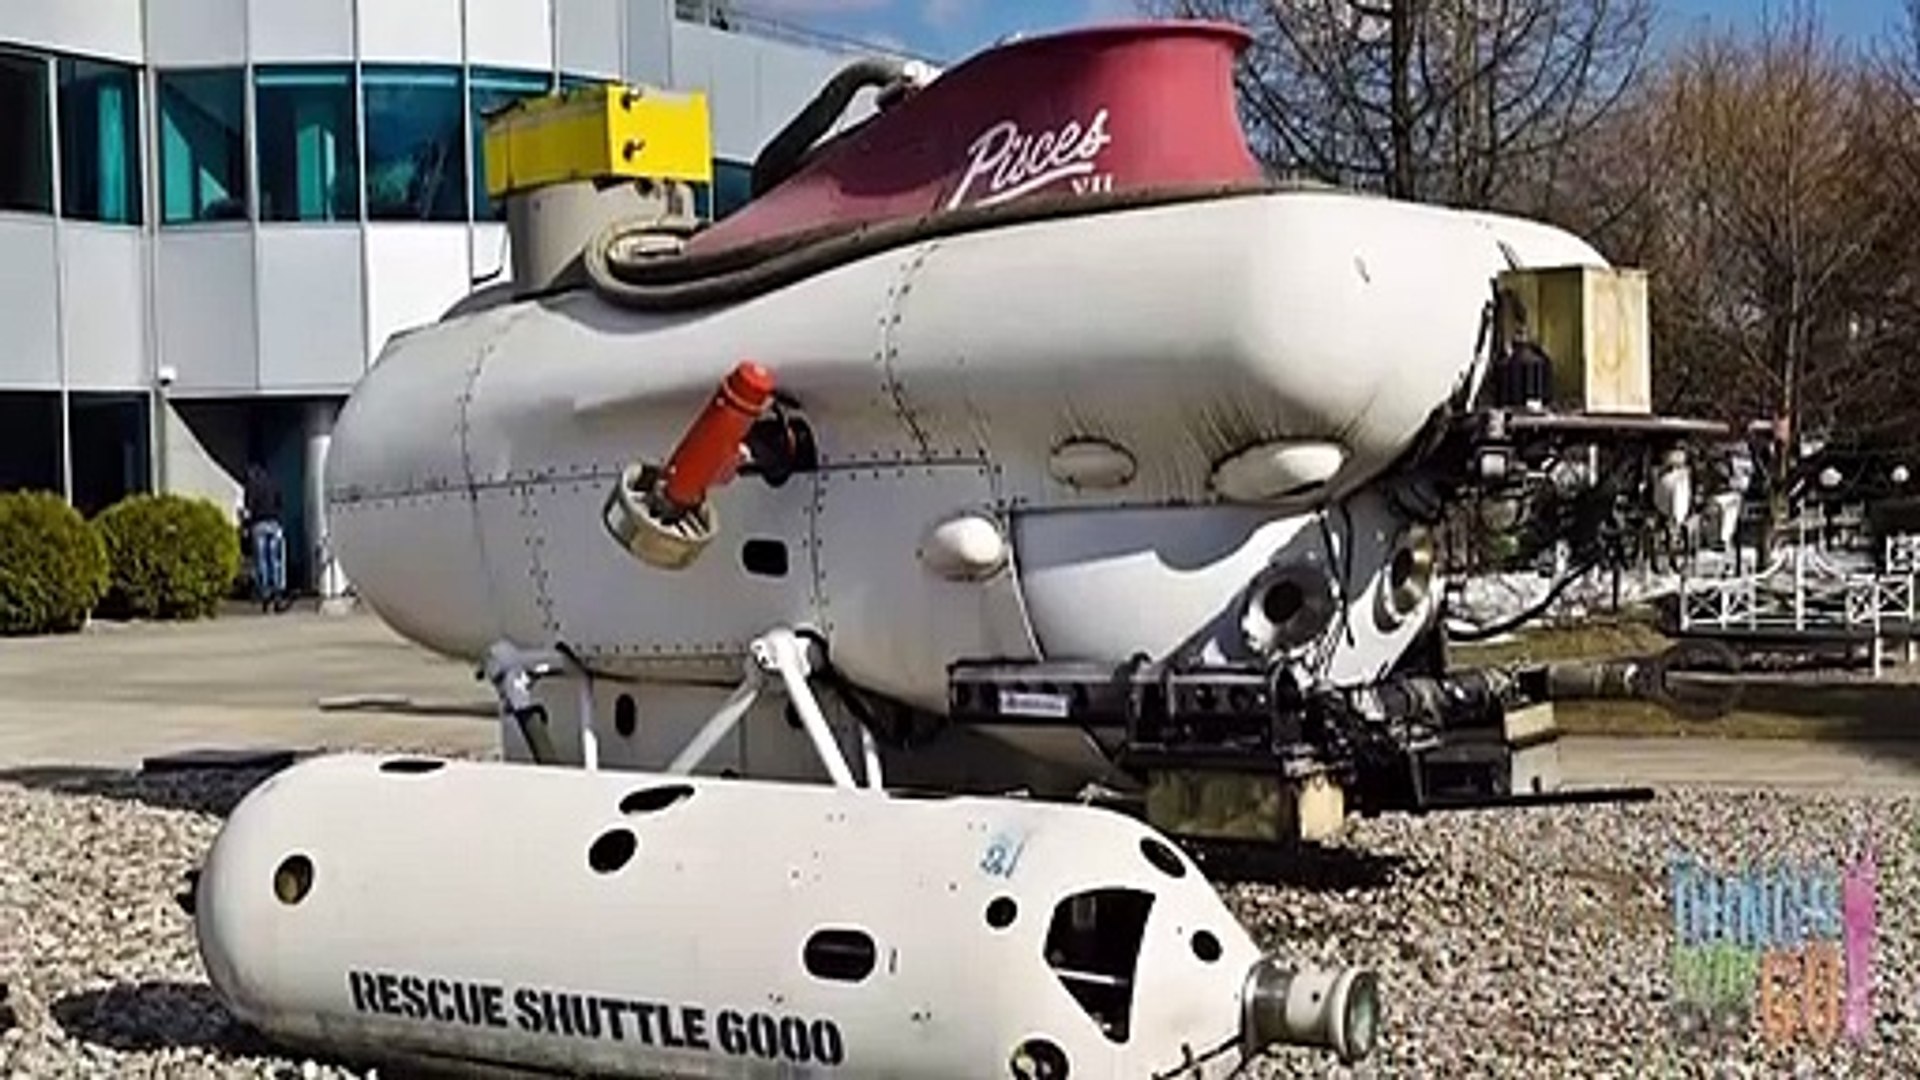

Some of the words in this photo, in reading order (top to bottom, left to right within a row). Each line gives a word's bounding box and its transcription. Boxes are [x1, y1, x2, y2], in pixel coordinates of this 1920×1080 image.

[947, 109, 1112, 212] Pisces
[1071, 174, 1113, 196] VII
[350, 971, 507, 1028] RESCUE
[515, 988, 711, 1051] SHUTTLE
[716, 1010, 845, 1066] 6000
